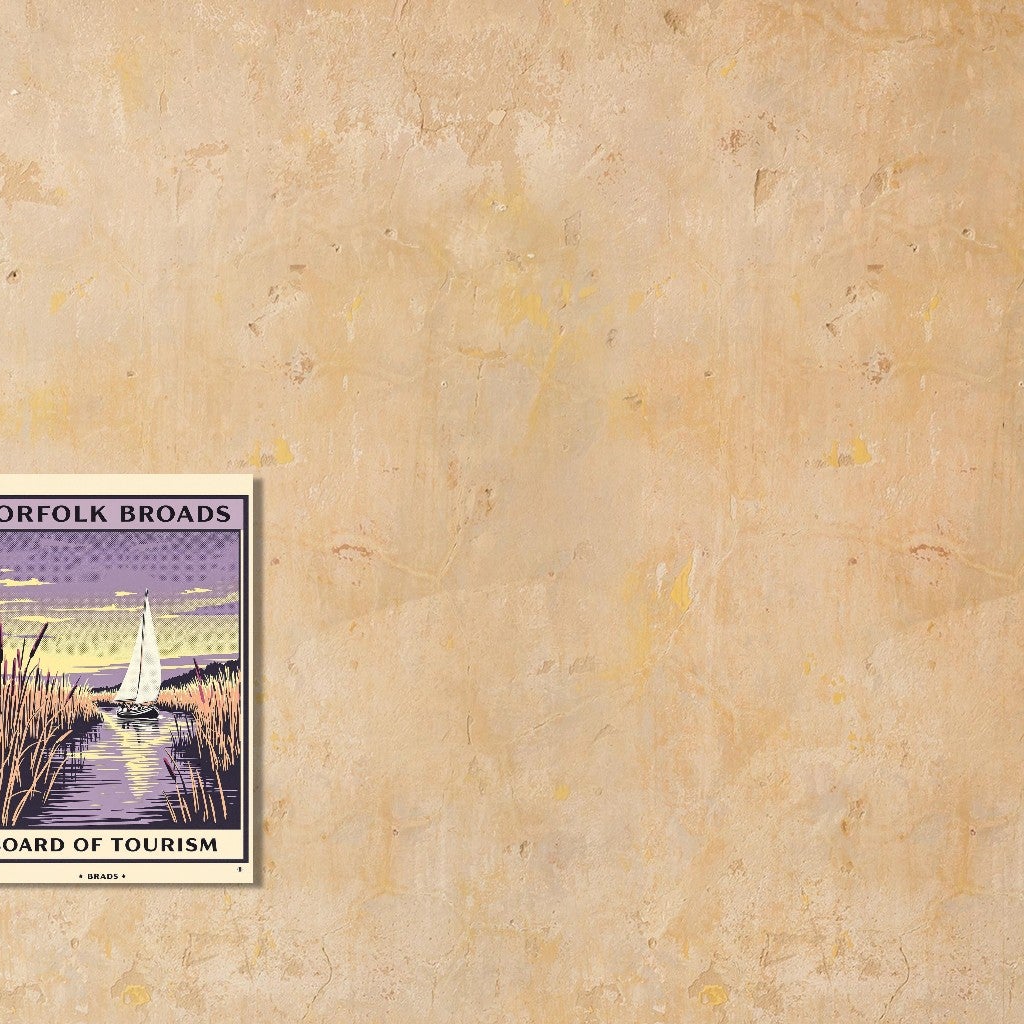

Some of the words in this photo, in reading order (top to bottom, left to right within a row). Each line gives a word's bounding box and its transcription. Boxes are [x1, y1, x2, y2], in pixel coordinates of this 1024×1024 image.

[120, 504, 232, 523] BROADS
[73, 837, 103, 852] OF
[111, 837, 218, 852] TOURISM
